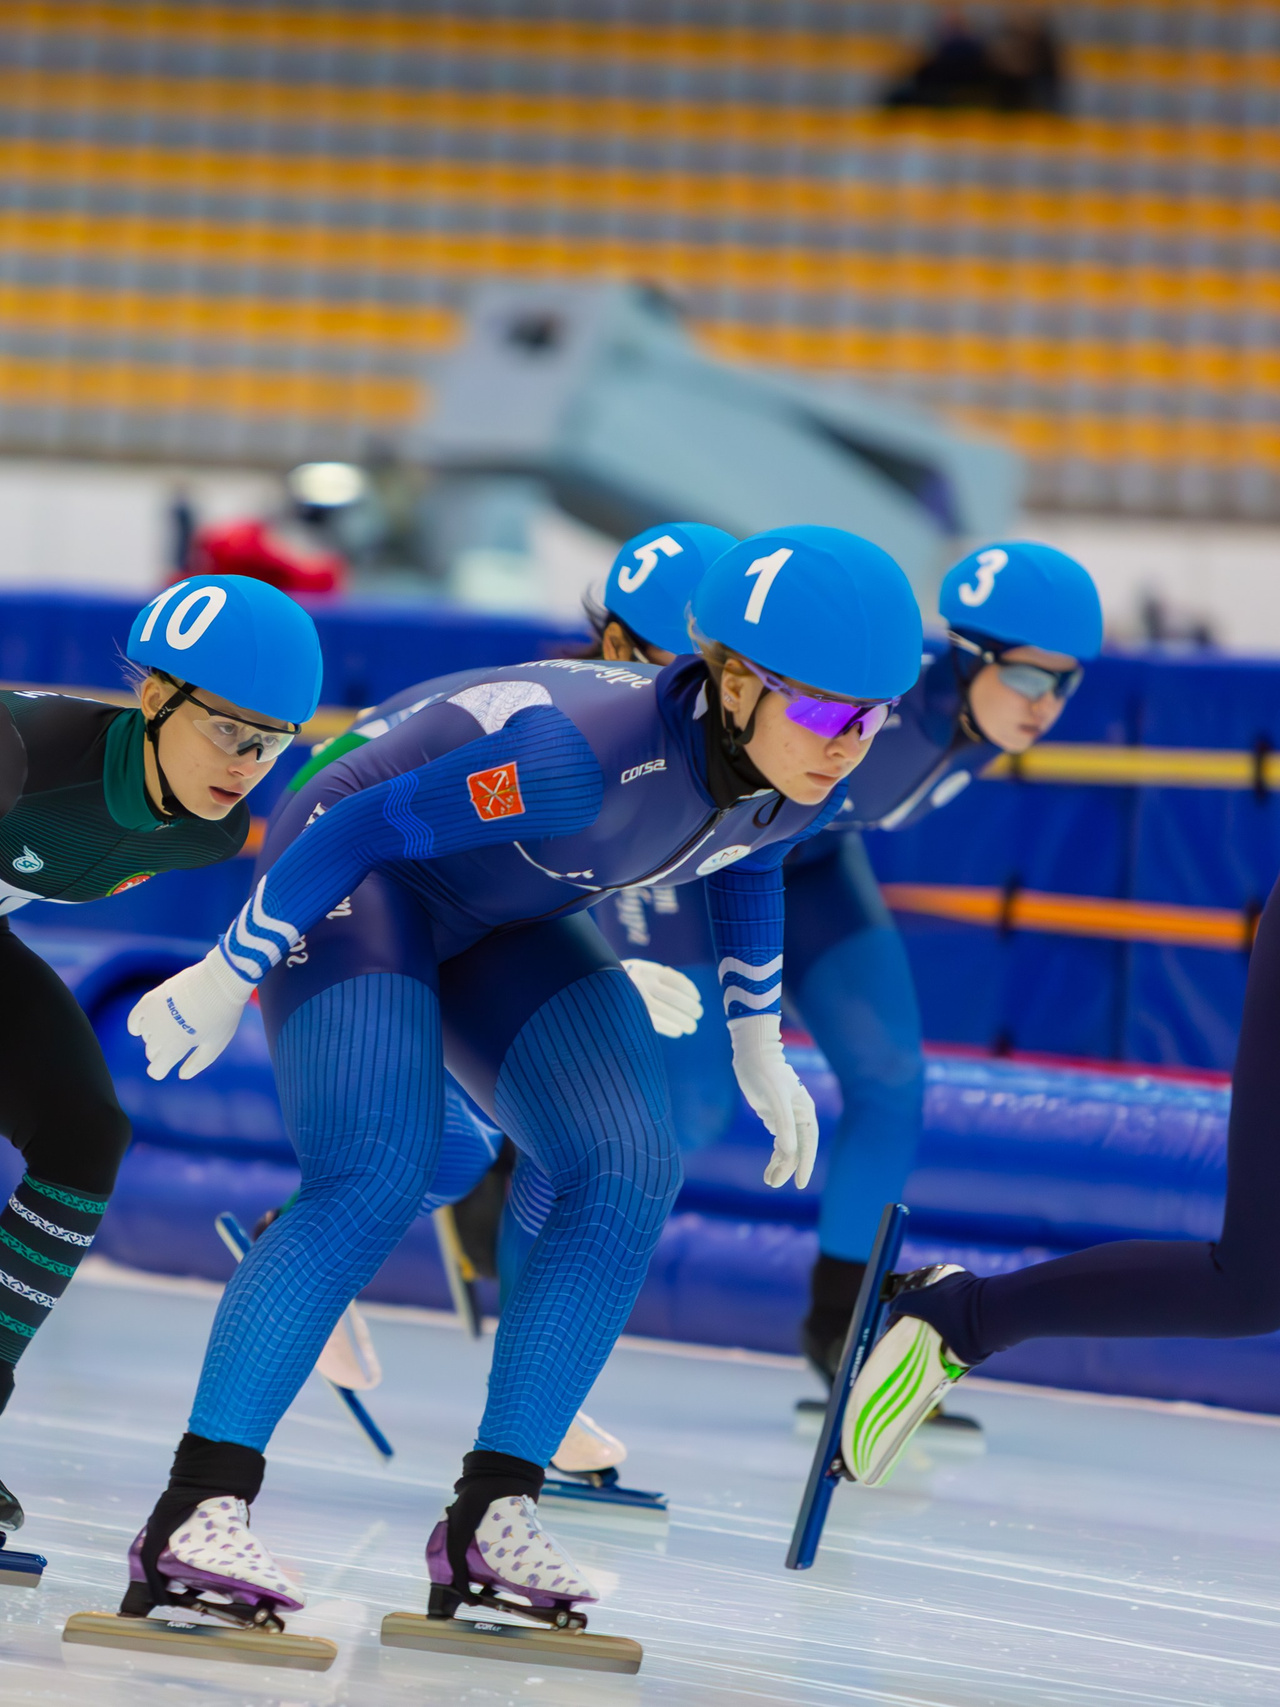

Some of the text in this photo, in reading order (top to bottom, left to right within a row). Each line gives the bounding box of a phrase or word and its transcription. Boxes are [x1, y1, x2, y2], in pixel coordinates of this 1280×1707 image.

[618, 535, 684, 593] 5
[744, 548, 794, 624] 1
[958, 549, 1009, 607] 3
[140, 581, 227, 650] 10
